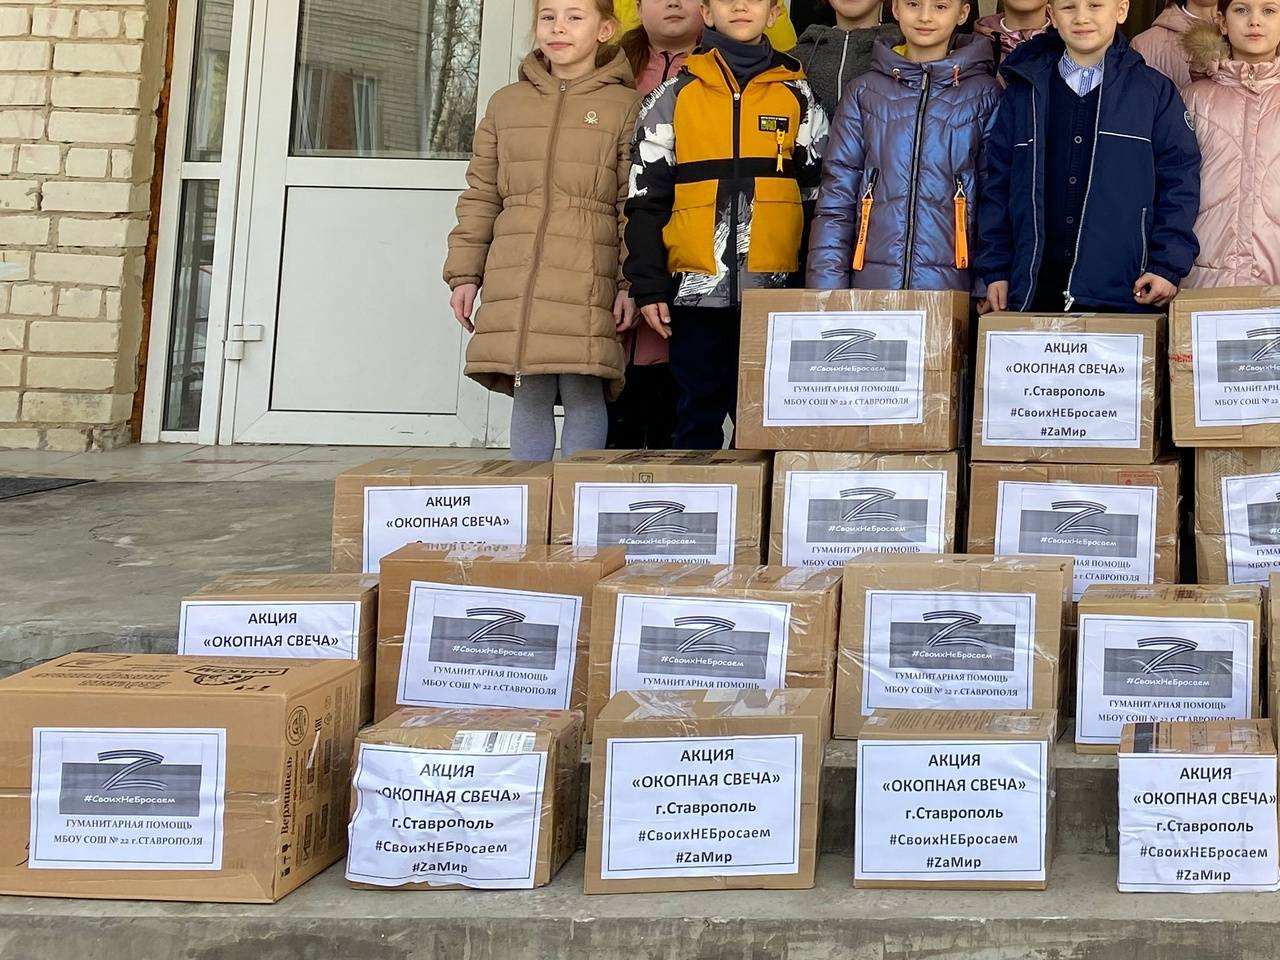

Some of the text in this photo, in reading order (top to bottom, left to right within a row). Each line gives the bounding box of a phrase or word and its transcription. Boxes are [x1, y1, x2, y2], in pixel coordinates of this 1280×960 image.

[1044, 342, 1087, 355] АКЦИЯ
[810, 364, 885, 372] #СвоихНеБросаем
[1006, 363, 1124, 374] «ОКОПНАЯ СВЕЧА»
[793, 385, 859, 393] ГУМАНИТАРНАЯ
[1024, 386, 1105, 398] г.Ставрополь
[1010, 408, 1116, 419] #СвоихНЕБросаем
[1041, 427, 1086, 438] #ZaМир
[426, 496, 470, 508] АКЦИЯ
[386, 516, 509, 528] «ОКОПНАЯ СВЕЧА»
[828, 525, 905, 533] #СвоихНеБросаем
[618, 537, 696, 545] #СвоихНеБросаем
[1040, 536, 1116, 546] #СвоихНеБросаем
[248, 613, 296, 626] АКЦИЯ
[204, 635, 338, 647] «ОКОПНАЯ СВЕЧА»
[451, 645, 534, 657] #СвоихНеБросаем
[911, 650, 992, 659] #СвоихНеБросаем
[660, 655, 745, 667] #СвоихНеБросаем
[433, 666, 548, 681] ГУМАНИТАРНАЯ ПОМОЩЬ
[895, 672, 1007, 682] ГУМАНИТАРНАЯ ПОМОЩЬ
[1126, 677, 1209, 687] #СвоихНеБросаем
[1109, 699, 1225, 710] ГУМАНИТАРНАЯ ПОМОЩЬ
[680, 749, 733, 763] АКЦИЯ
[928, 754, 980, 769] АКЦИЯ
[420, 764, 474, 780] АКЦИЯ
[1180, 767, 1231, 782] АКЦИЯ
[632, 771, 780, 787] «ОКОПНАЯ СВЕЧА»
[882, 778, 1025, 792] «ОКОПНАЯ СВЕЧА»
[83, 795, 175, 804] #СвоихНеБросаем
[280, 756, 293, 834] Вермишель
[461, 790, 520, 802] СВЕЧА»
[1133, 792, 1276, 804] «ОКОПНАЯ СВЕЧА»
[656, 802, 756, 816] г.Ставрополь
[906, 806, 1003, 822] г.Ставрополь
[66, 819, 192, 829] ГУМАНИТАРНАЯ ПОМОЩЬ
[392, 817, 493, 832] г.Ставрополь
[1157, 820, 1253, 834] г.Ставрополь
[53, 835, 83, 843] МБОУ
[83, 835, 106, 843] СОШ
[132, 836, 202, 845] г.СТАВРОПОЛЯ
[638, 828, 770, 841] #СвоихНЕБросаем
[890, 834, 1017, 847] #СвоихНЕБросаем
[375, 840, 506, 854] #СвоихНЕБросаем
[1140, 845, 1267, 860] #СвоихНЕБросаем
[676, 851, 732, 863] #ZaМир
[926, 856, 981, 868] #ZaМир
[412, 861, 467, 876] #ZaМир
[1176, 869, 1230, 881] #ZaМир
